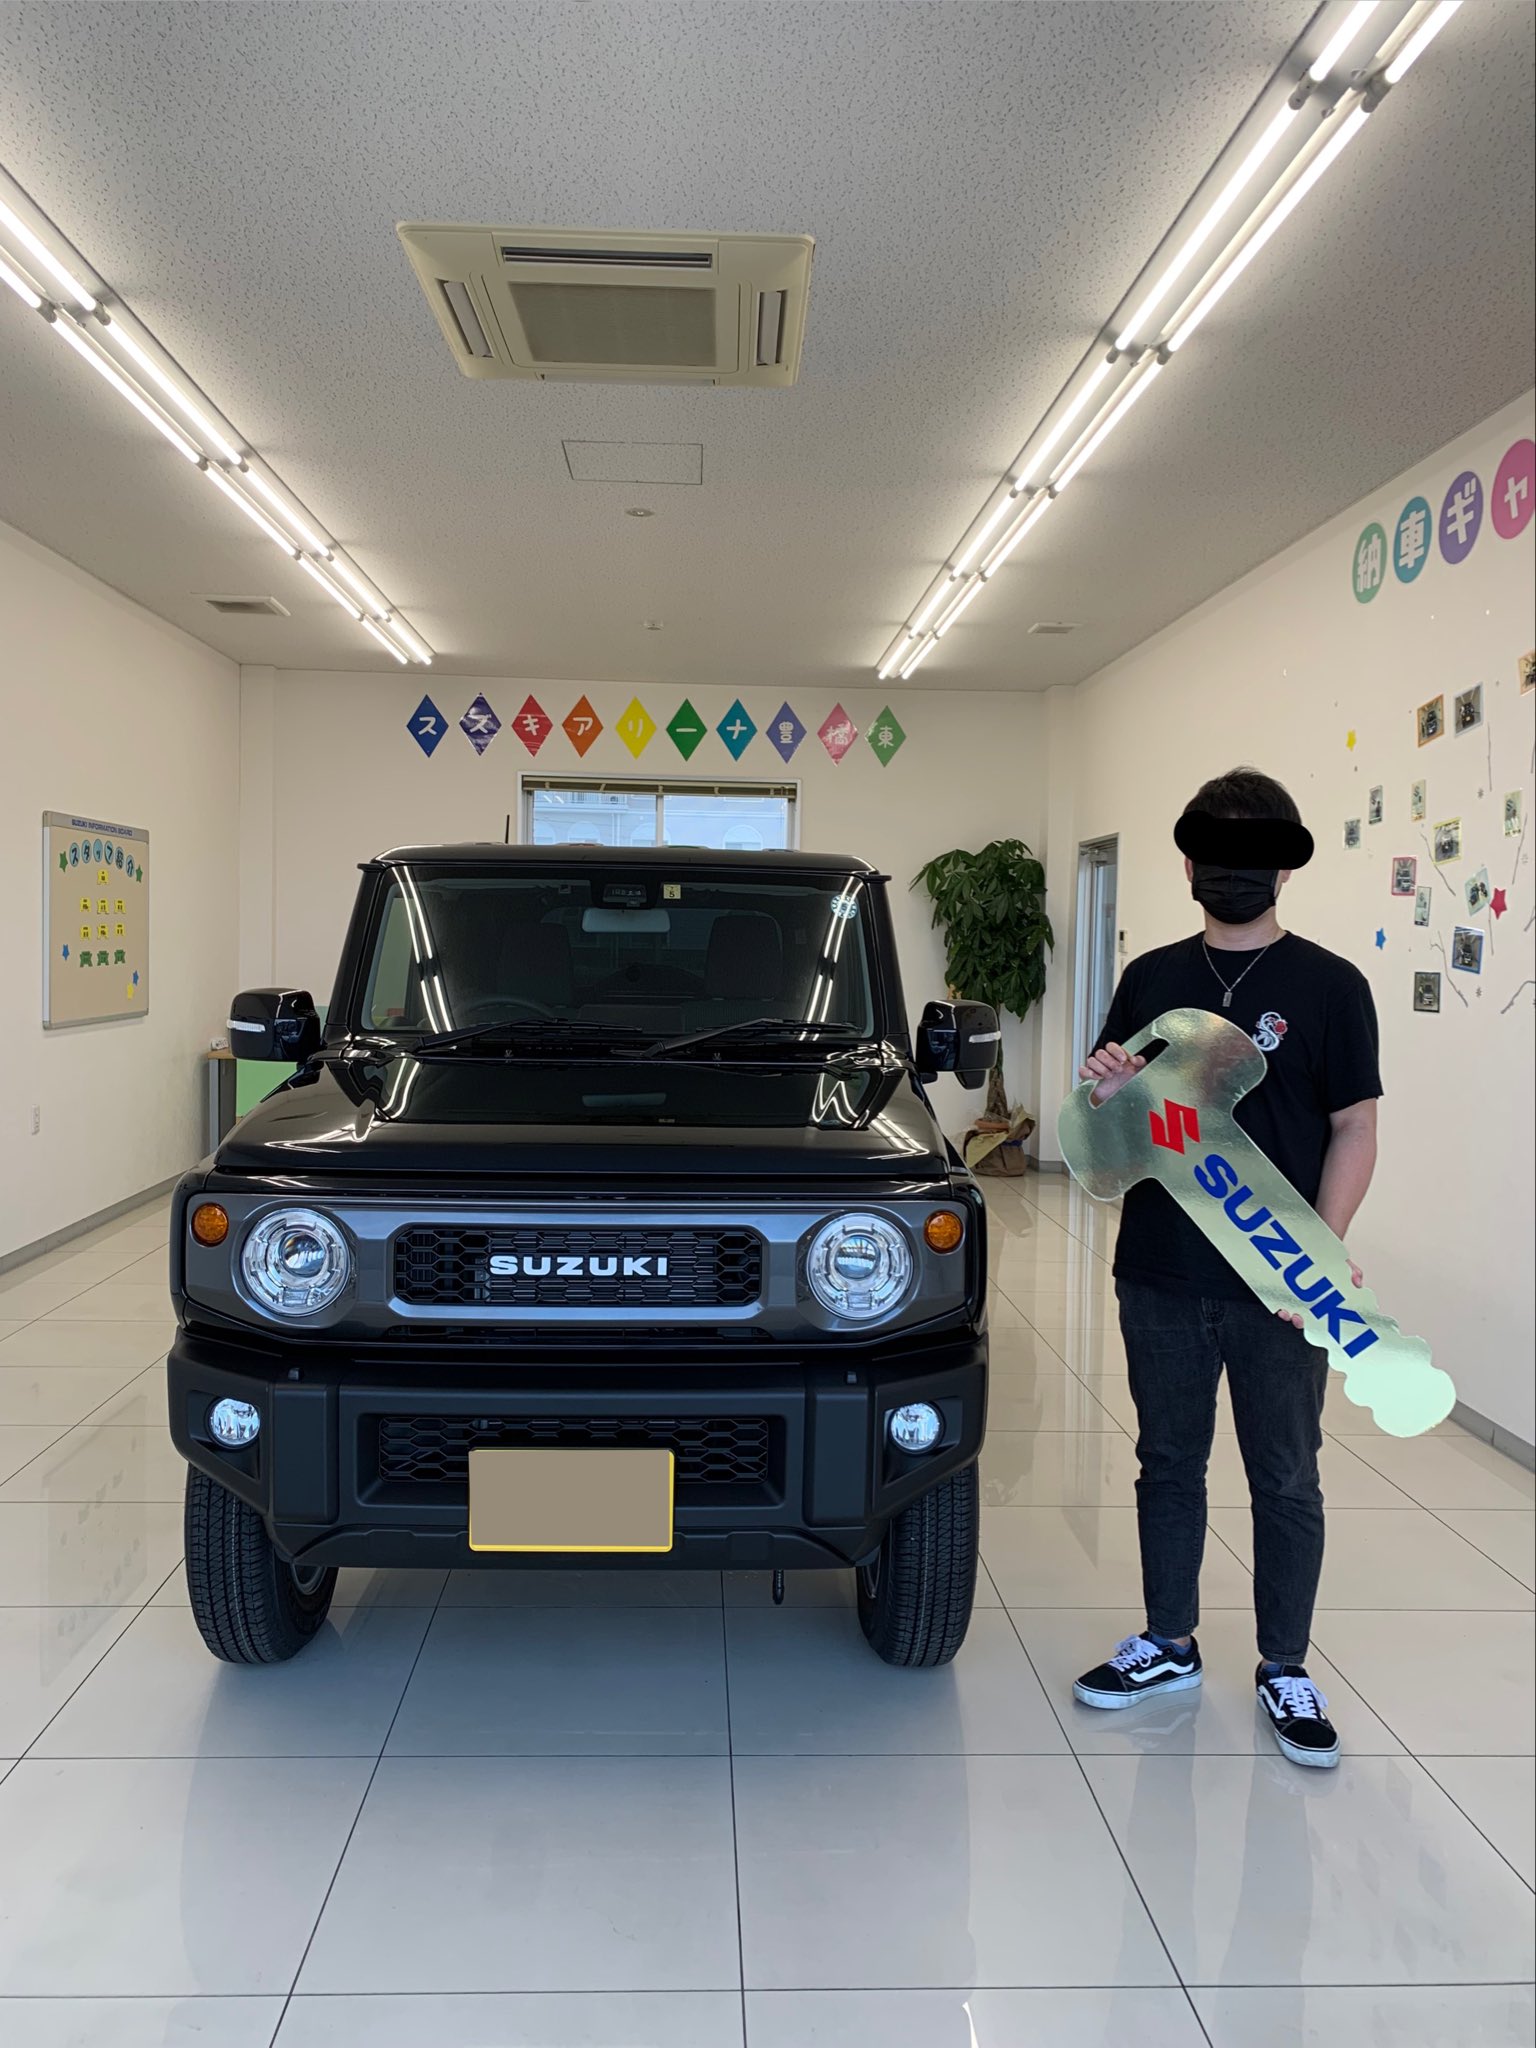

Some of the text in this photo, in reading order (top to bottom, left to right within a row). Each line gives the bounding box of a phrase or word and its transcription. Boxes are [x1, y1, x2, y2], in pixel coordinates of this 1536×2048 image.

[417, 714, 895, 747] スズキアリーナ豊橋東
[489, 1255, 668, 1276] SUZUKI
[1194, 1154, 1380, 1358] SUZUKI
